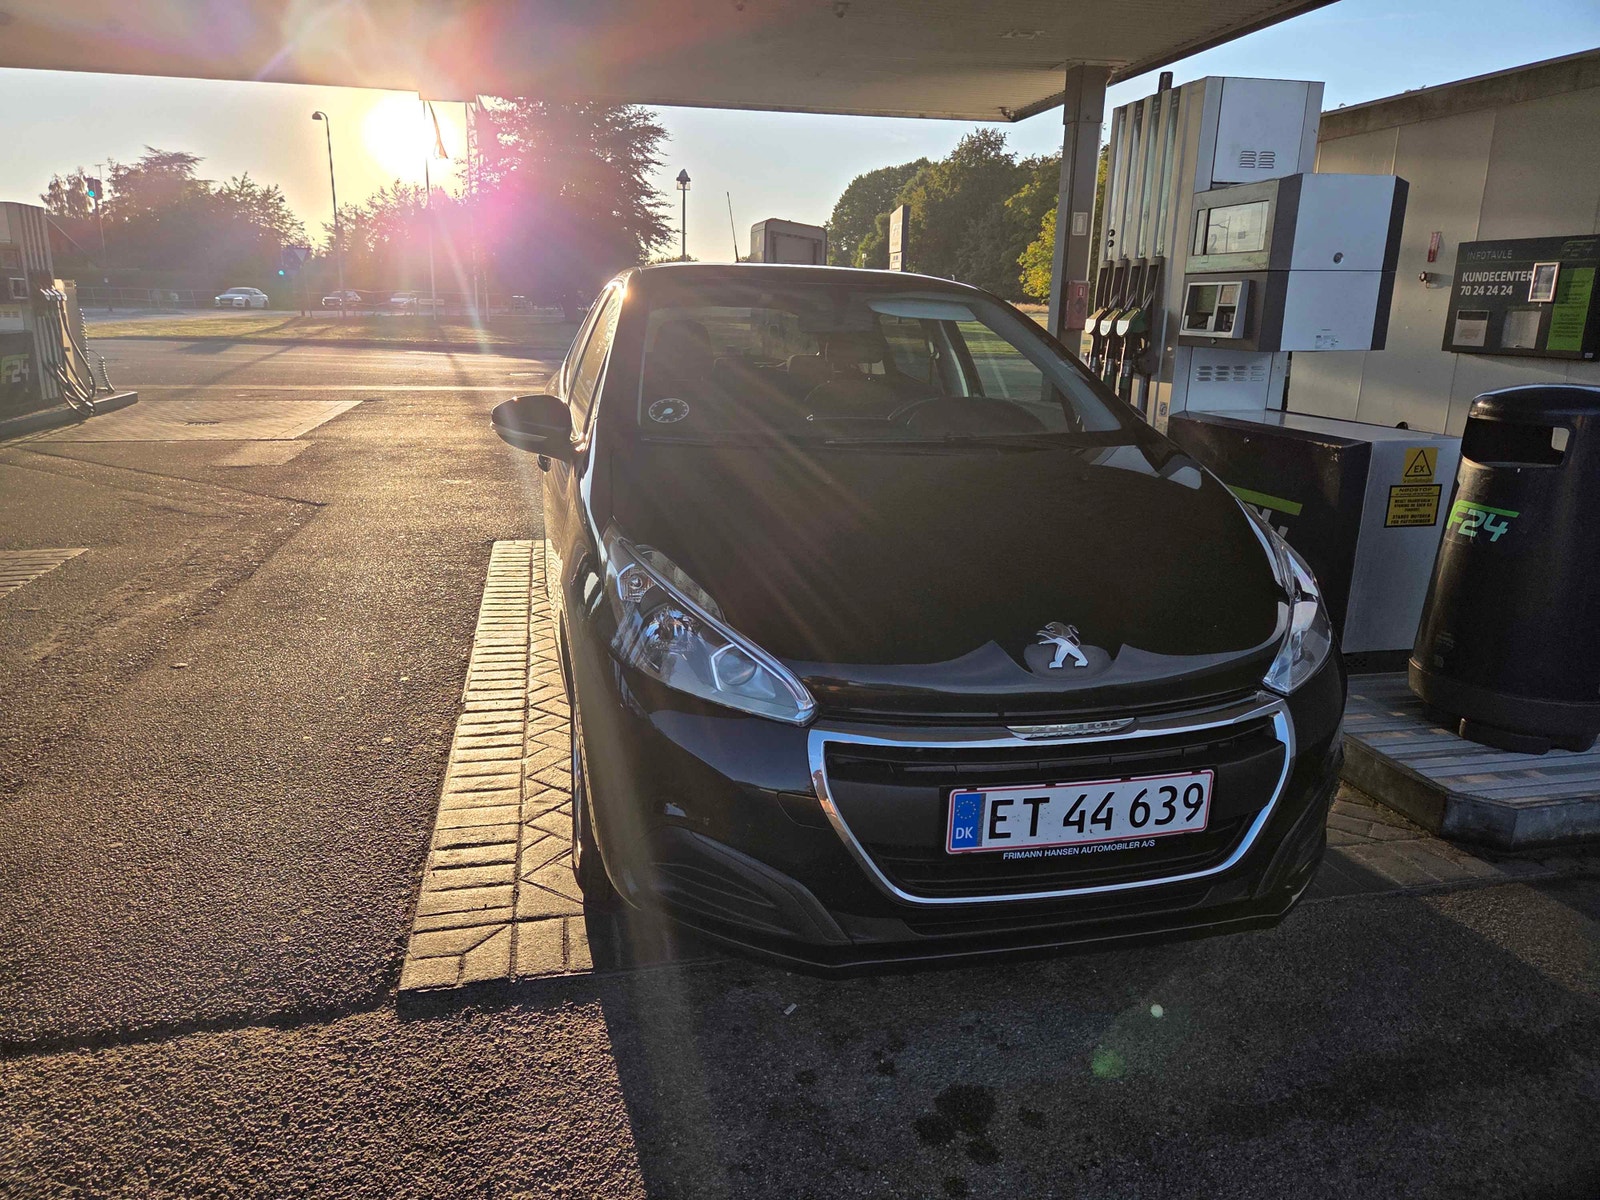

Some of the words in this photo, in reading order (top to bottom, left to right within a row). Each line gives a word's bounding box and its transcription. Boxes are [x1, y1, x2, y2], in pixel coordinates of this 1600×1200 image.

[1466, 249, 1513, 260] INFOTAVLE
[1462, 270, 1533, 283] KUNDECENTER
[1460, 285, 1471, 296] 70
[1472, 285, 1485, 296] 24
[1486, 285, 1499, 296] 24
[1500, 285, 1513, 296] 24
[1, 354, 30, 384] F24
[1413, 464, 1426, 473] EX
[1447, 500, 1520, 542] F24
[955, 827, 973, 839] DK
[988, 796, 1050, 840] ET
[1062, 791, 1115, 834] 44
[1129, 782, 1204, 829] 639
[1003, 850, 1043, 860] FRIMANN
[1044, 847, 1080, 857] HANSEN
[1080, 841, 1140, 855] AUTOMOBILER
[1141, 839, 1156, 848] A/S
